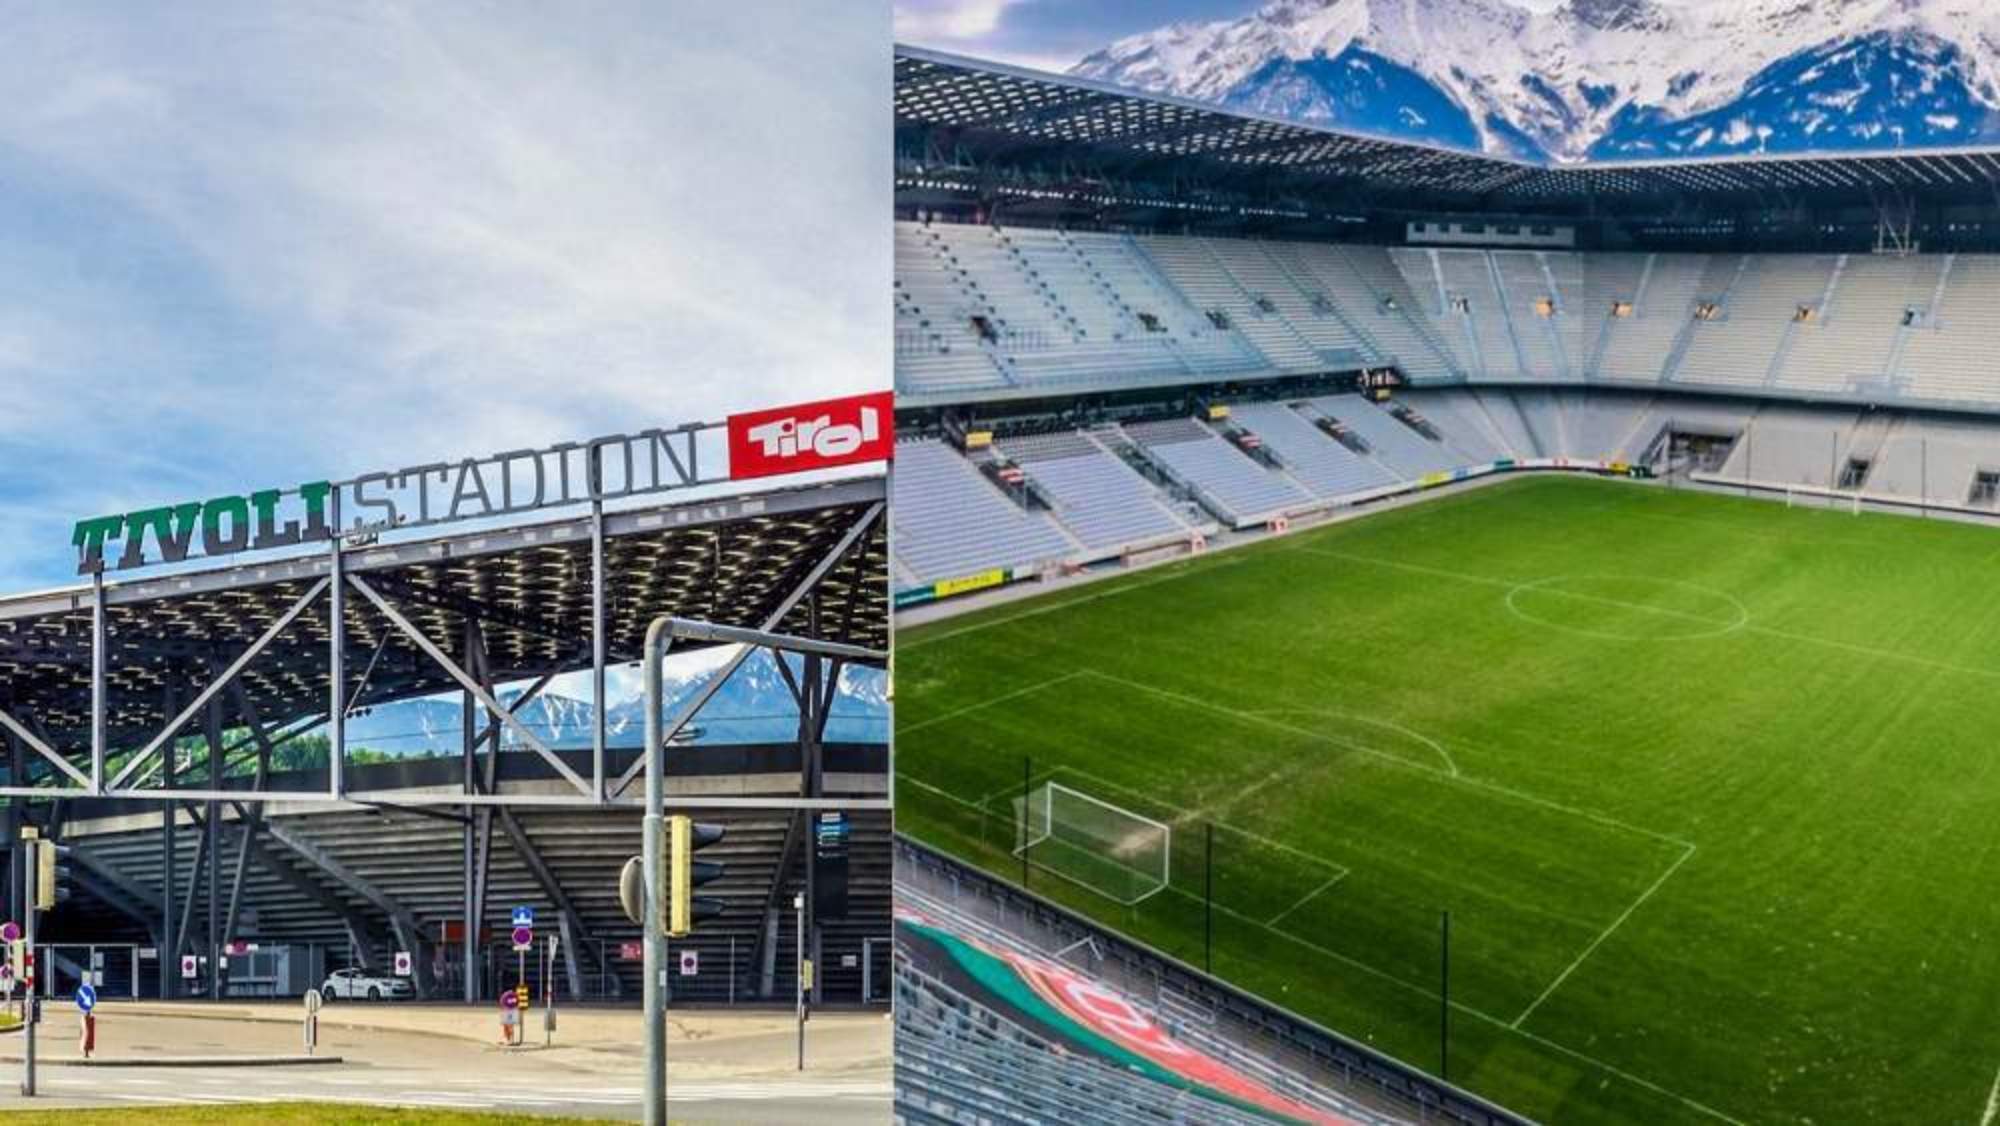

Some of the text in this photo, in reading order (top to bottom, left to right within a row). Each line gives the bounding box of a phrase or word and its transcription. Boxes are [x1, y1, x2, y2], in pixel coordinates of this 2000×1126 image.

[748, 406, 878, 457] Tirol
[72, 422, 704, 575] TIVOLI STADION
